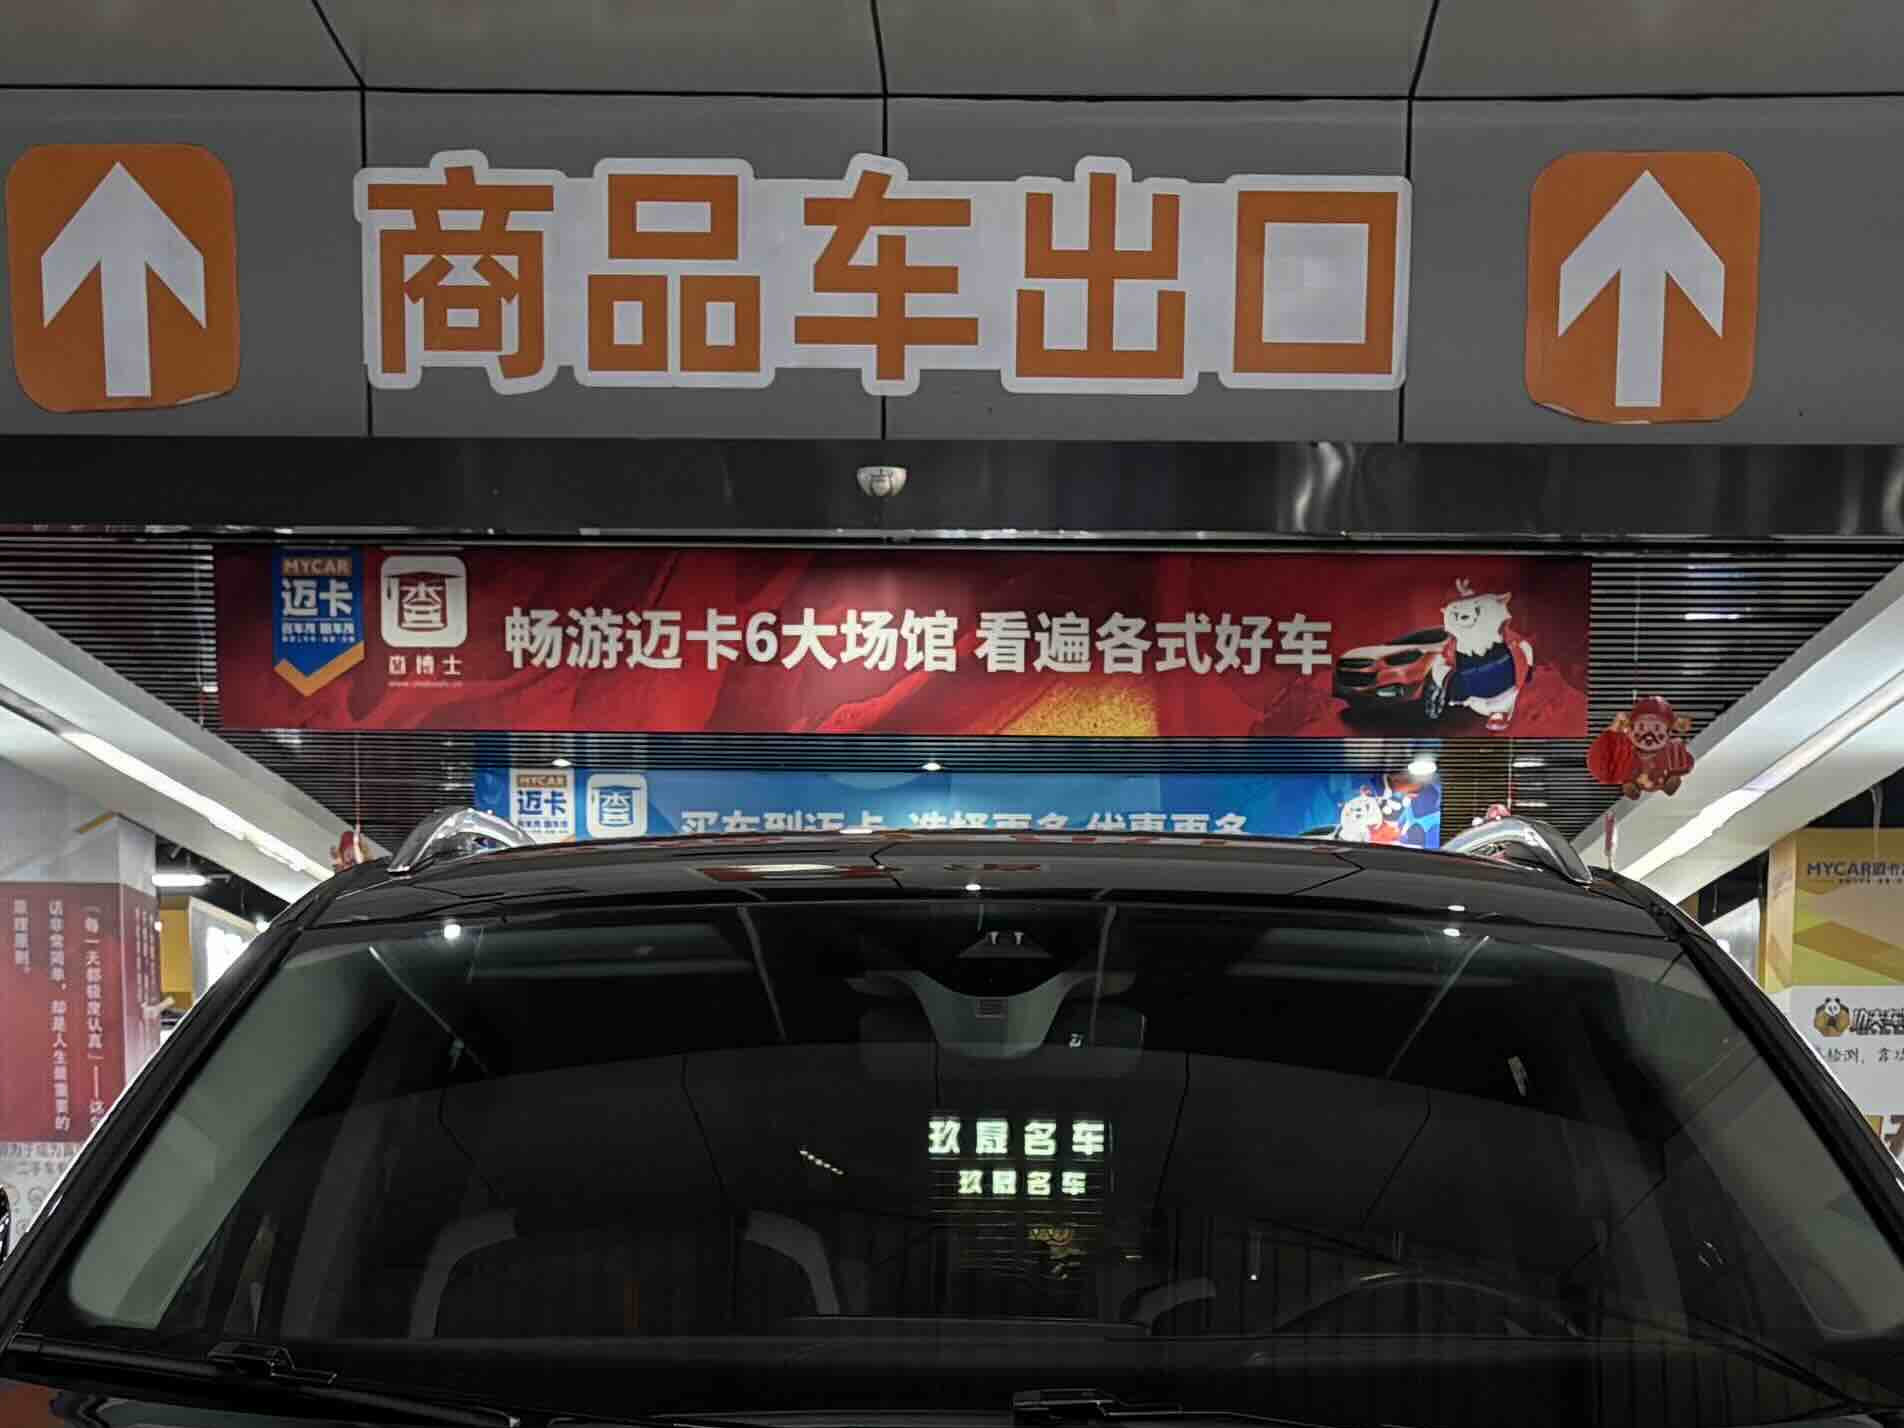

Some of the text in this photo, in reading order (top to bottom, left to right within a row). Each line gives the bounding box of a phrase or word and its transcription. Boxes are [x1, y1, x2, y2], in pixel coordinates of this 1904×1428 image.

[364, 165, 1402, 382] 商品车出口
[282, 559, 352, 576] MYCAR
[281, 578, 353, 617] 迈卡
[504, 606, 1333, 677] 畅游迈卡6大场馆 看遍各式好车
[517, 789, 569, 817] 迈卡
